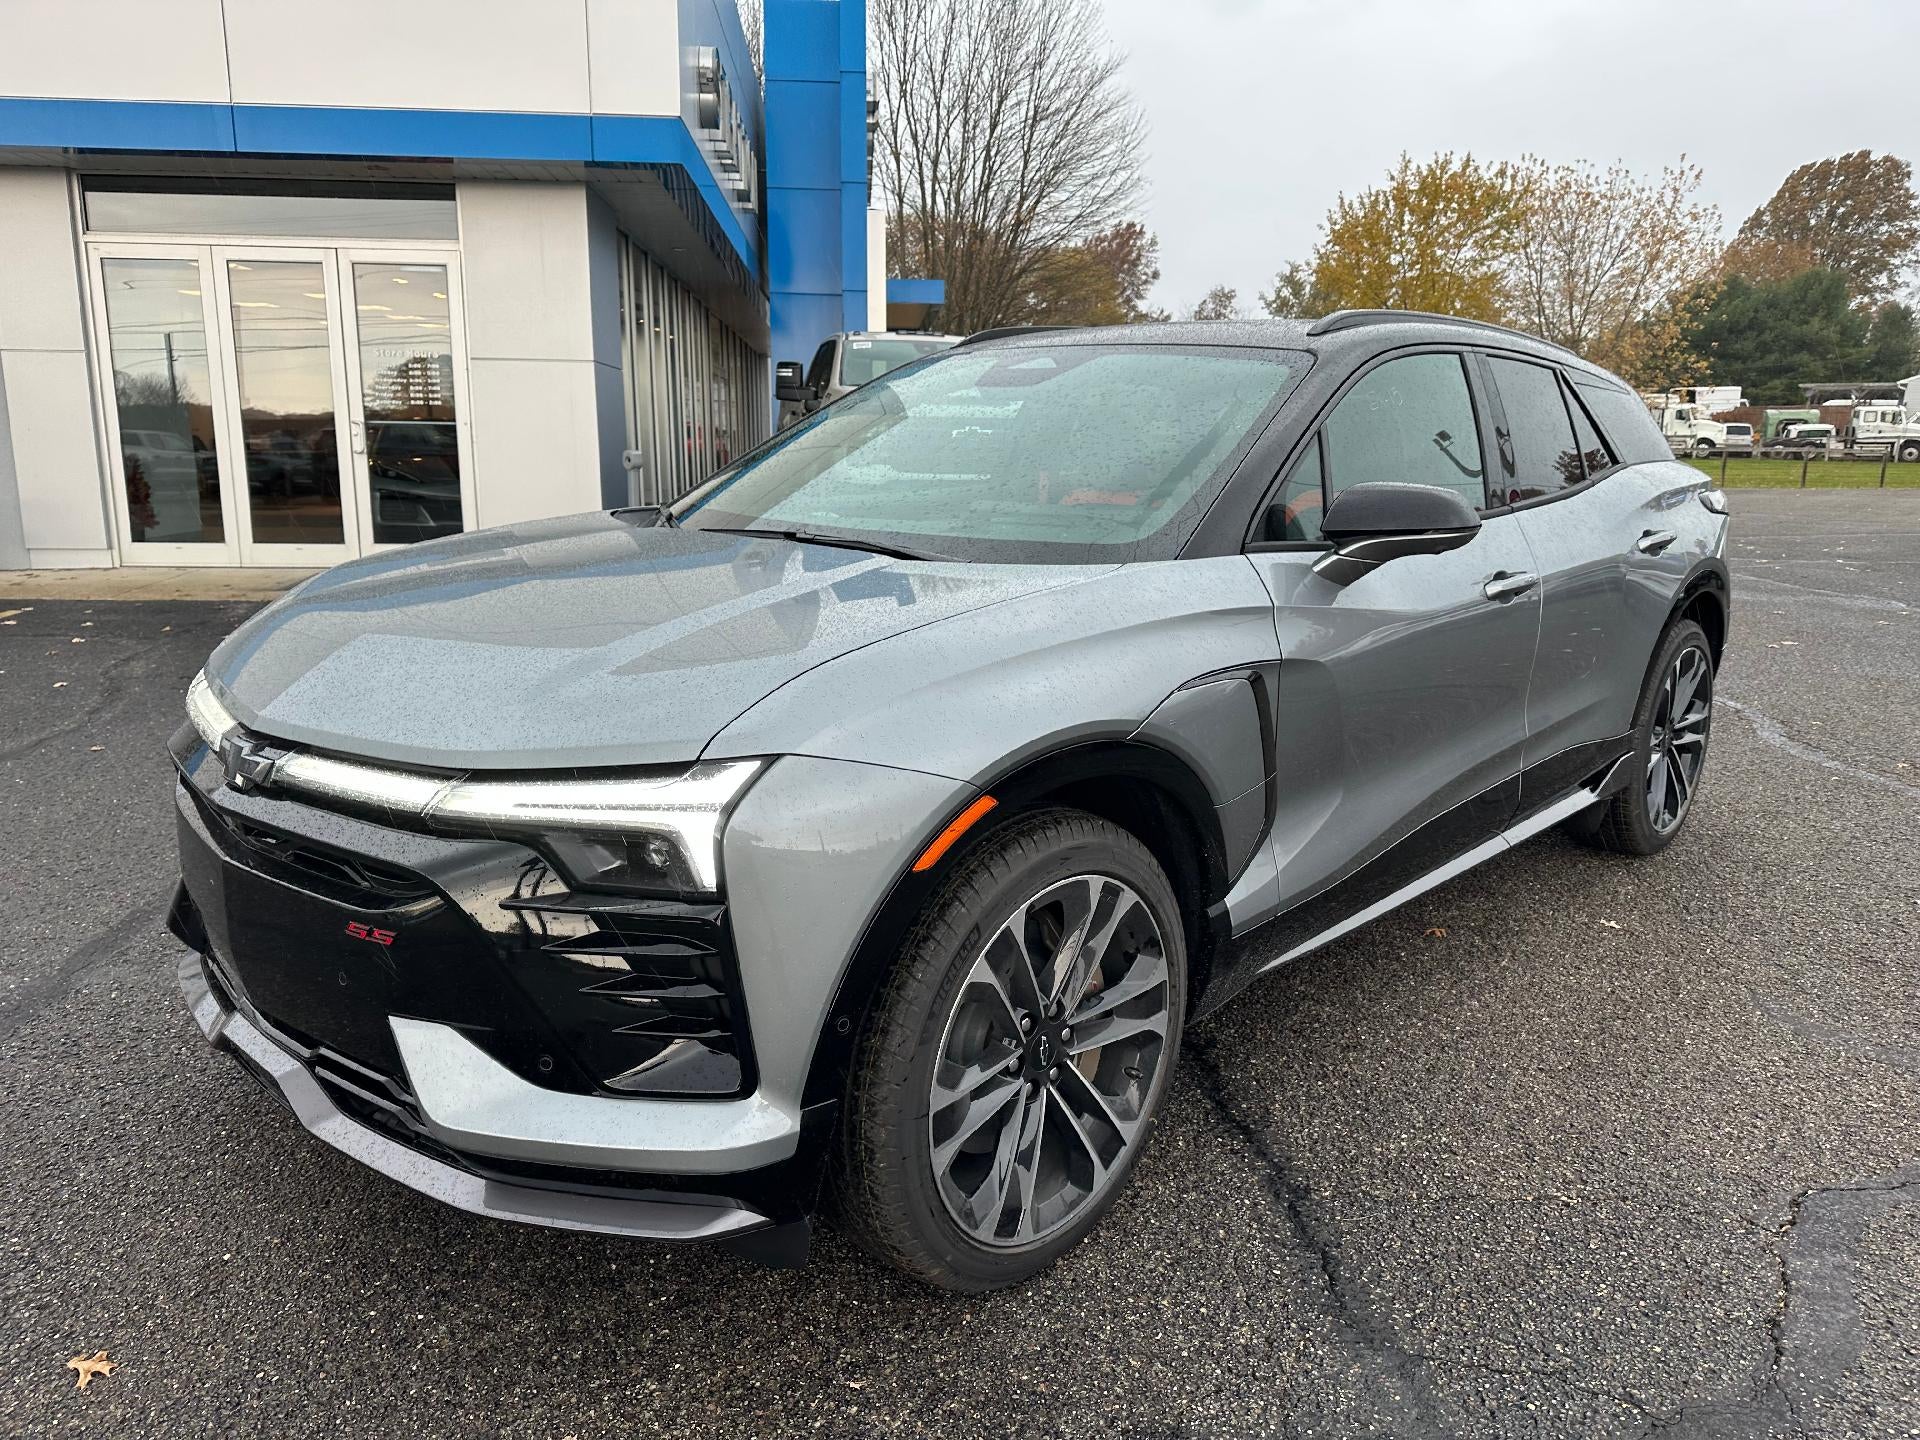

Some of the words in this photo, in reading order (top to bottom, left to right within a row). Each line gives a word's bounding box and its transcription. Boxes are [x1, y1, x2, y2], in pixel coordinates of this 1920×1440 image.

[375, 349, 403, 358] Store
[406, 349, 439, 359] Hours
[345, 921, 397, 945] SS
